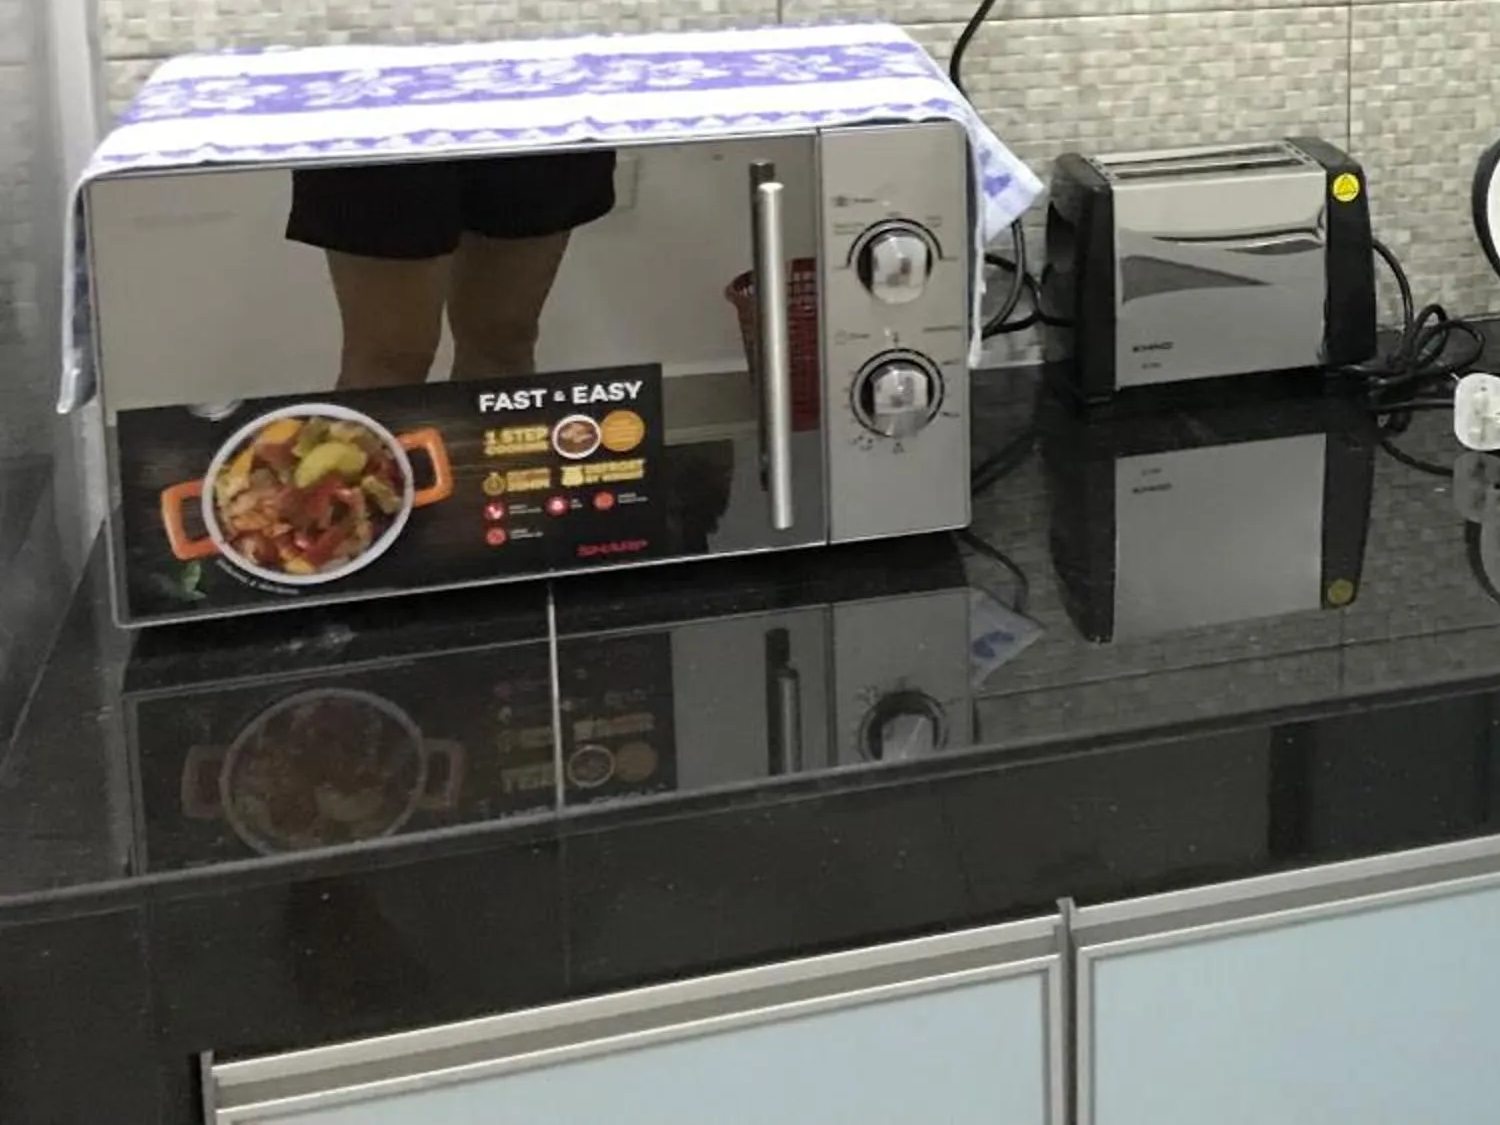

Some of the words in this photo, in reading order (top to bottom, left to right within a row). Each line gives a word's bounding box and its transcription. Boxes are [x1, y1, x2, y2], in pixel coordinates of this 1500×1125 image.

[478, 389, 547, 412] FAST
[553, 390, 565, 402] &
[572, 381, 643, 404] EASY
